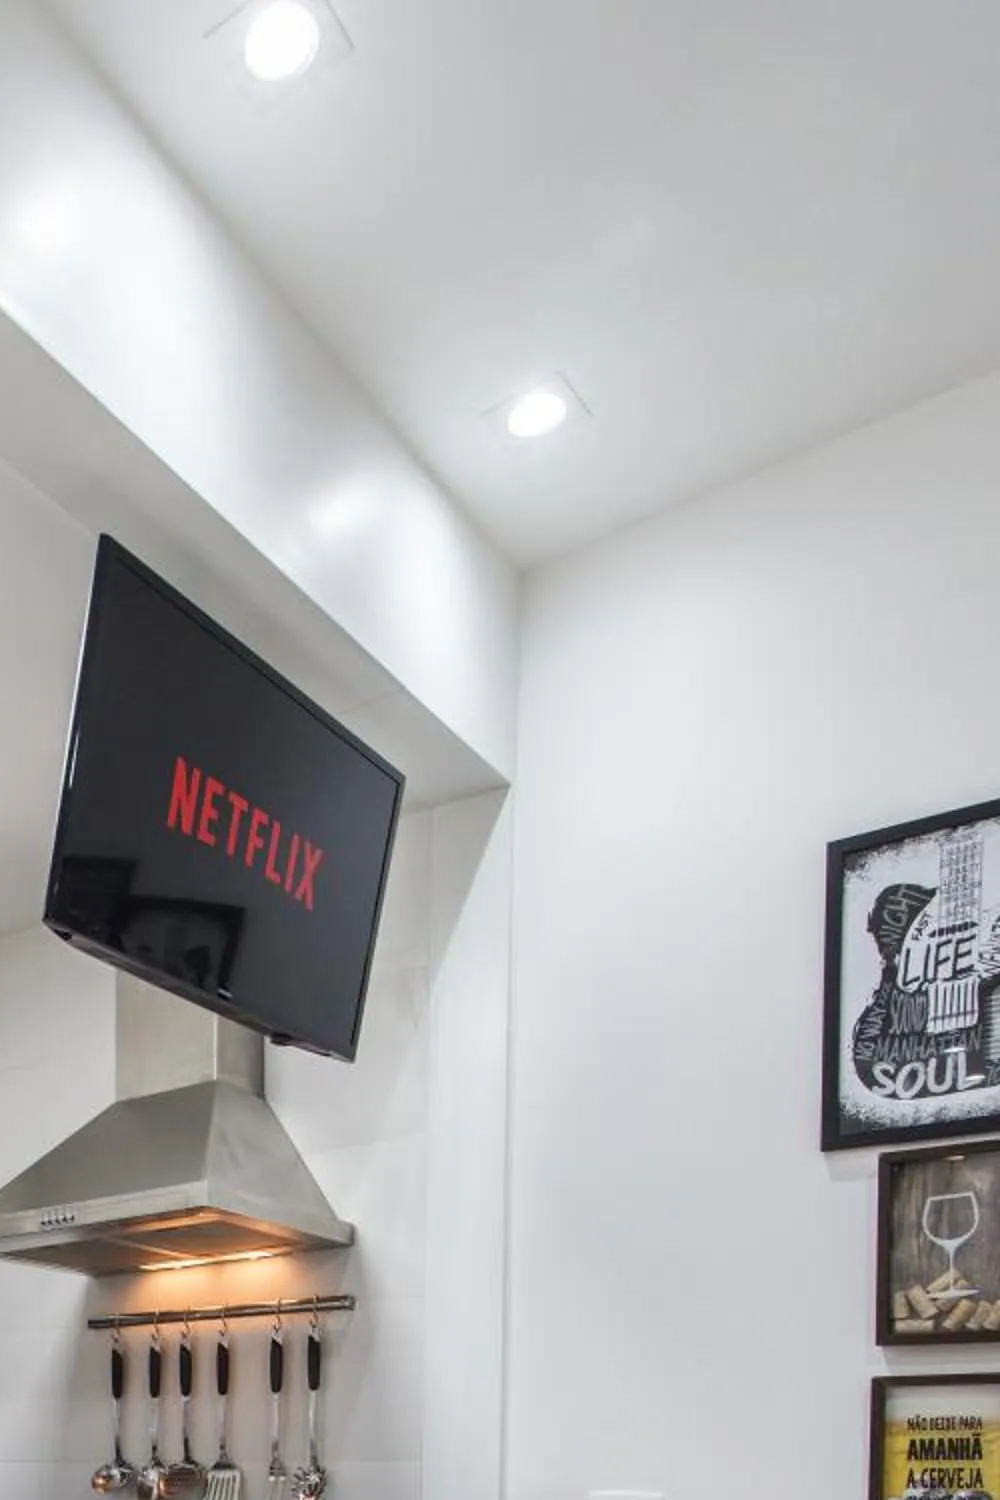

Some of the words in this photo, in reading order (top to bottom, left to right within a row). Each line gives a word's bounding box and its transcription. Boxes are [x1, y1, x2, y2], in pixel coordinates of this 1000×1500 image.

[167, 756, 327, 911] NETFLIX
[902, 934, 977, 987] LIFE
[872, 1051, 985, 1099] SOUL
[907, 1414, 927, 1430] NÃO
[960, 1416, 983, 1430] PARA
[907, 1433, 983, 1461] AMANHÃ
[906, 1468, 917, 1488] A
[921, 1467, 984, 1489] CERVEJA
